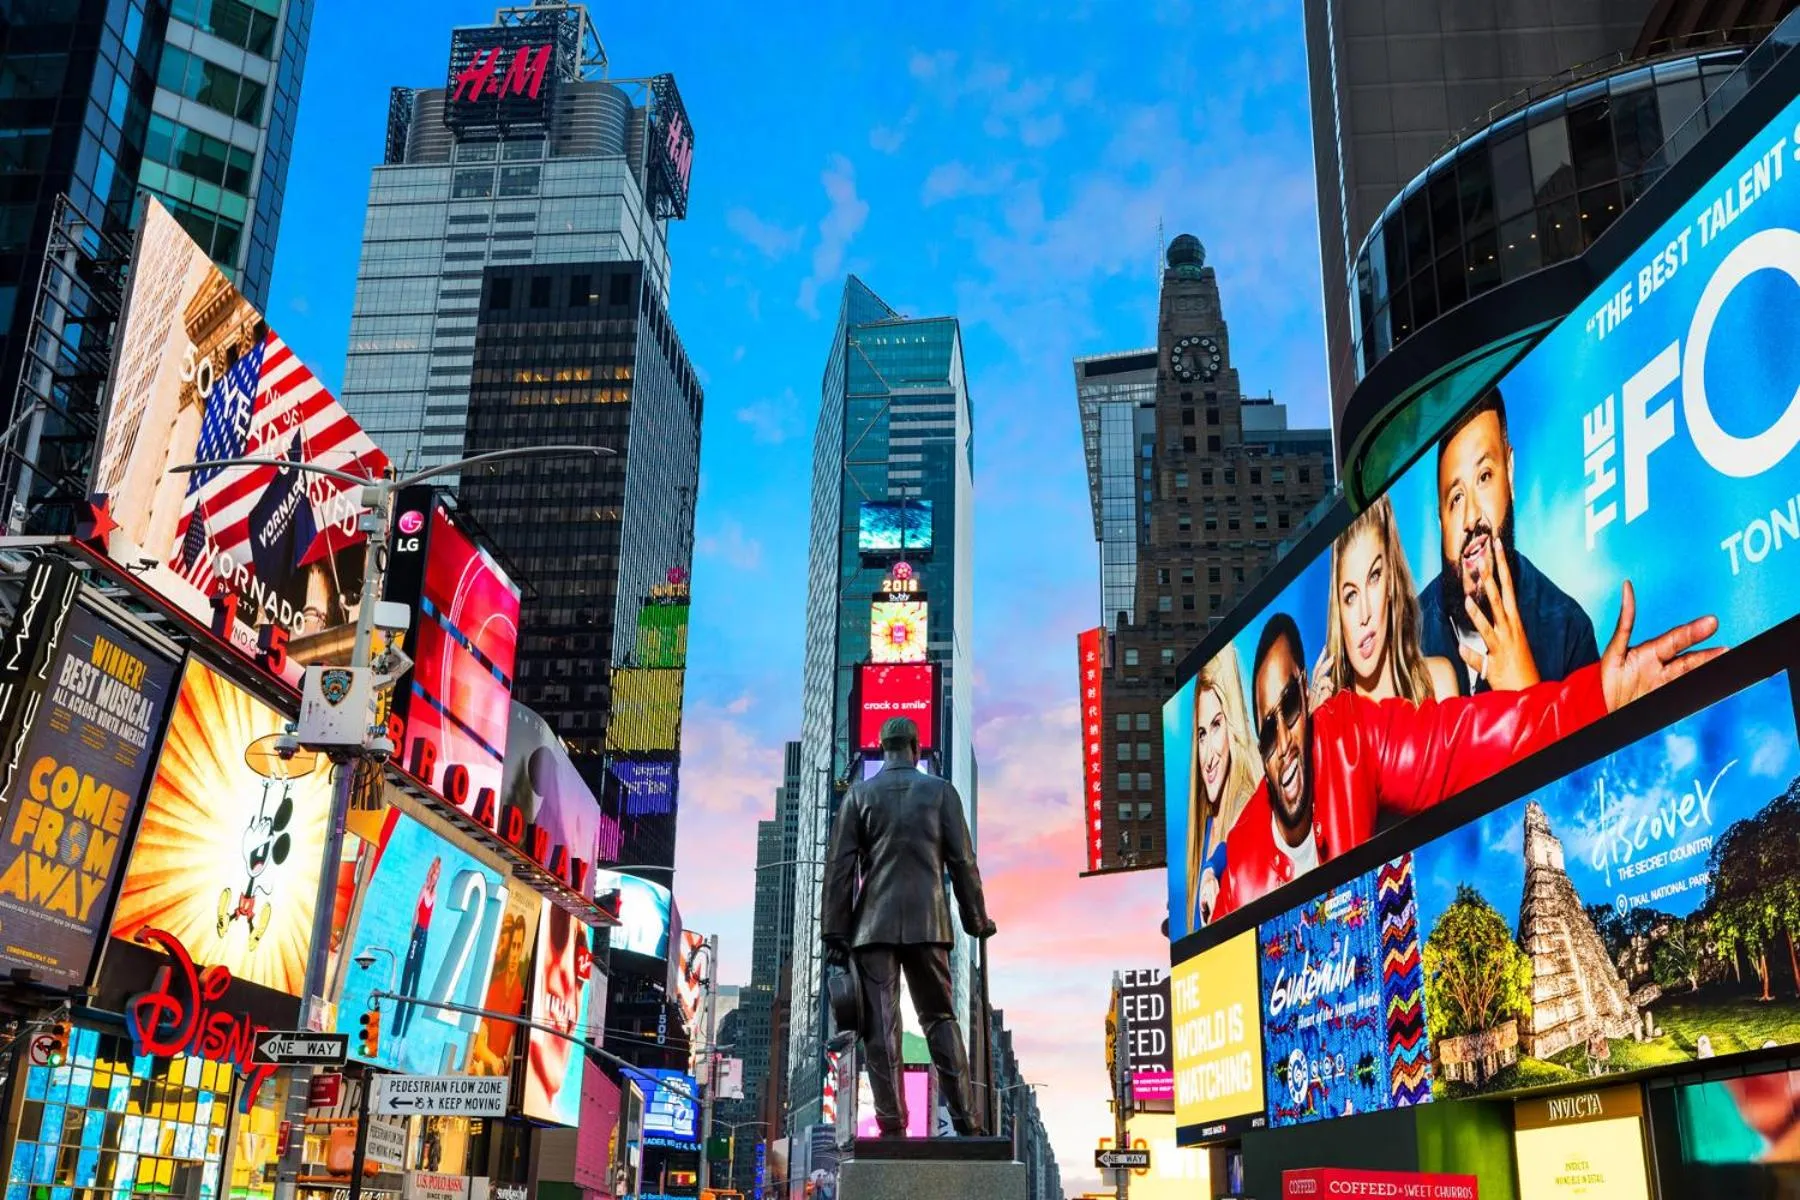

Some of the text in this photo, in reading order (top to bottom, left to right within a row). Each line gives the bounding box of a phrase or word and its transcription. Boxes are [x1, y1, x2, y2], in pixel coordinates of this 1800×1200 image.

[452, 43, 552, 103] H&M
[1638, 225, 1691, 305] BEST
[1697, 135, 1787, 244] TALENT
[179, 342, 214, 399] 50
[1583, 392, 1617, 553] THE
[397, 538, 420, 553] LG
[205, 535, 306, 635] VORNADO
[217, 581, 256, 615] RELTY
[883, 579, 918, 593] 2018
[91, 634, 148, 691] WINNER!
[52, 687, 69, 707] ALL
[67, 693, 99, 722] ACROSS
[97, 707, 119, 734] NORTH
[117, 721, 148, 750] AMERICA
[59, 653, 100, 700] BEST
[95, 674, 154, 733] MUSICAL
[863, 699, 891, 710] crack
[29, 756, 131, 836] COME
[1592, 759, 1738, 888] discover
[0, 850, 107, 922] AWAY
[1617, 835, 1713, 880] THE SECRET COUNTRY
[1629, 871, 1711, 908] TIKAL NATIONAL PARK
[1174, 971, 1200, 1015] THE
[1270, 935, 1358, 1017] Guatemala
[127, 925, 279, 1115] Disny
[268, 1041, 337, 1056] ONE WAY
[1175, 1003, 1244, 1061] WORLD IS
[389, 1080, 502, 1094] PEDESTRIAN FLOW ZONE
[438, 1098, 501, 1111] KEEP MOVING
[1176, 1050, 1252, 1107] WATCHING
[1547, 1092, 1603, 1121] INVICTA
[1102, 1154, 1143, 1163] ONE WAY
[1289, 1178, 1317, 1194] COFFEED
[1329, 1180, 1397, 1196] COFFEED
[1403, 1184, 1432, 1198] SWEET
[1434, 1185, 1472, 1199] CHURROS
